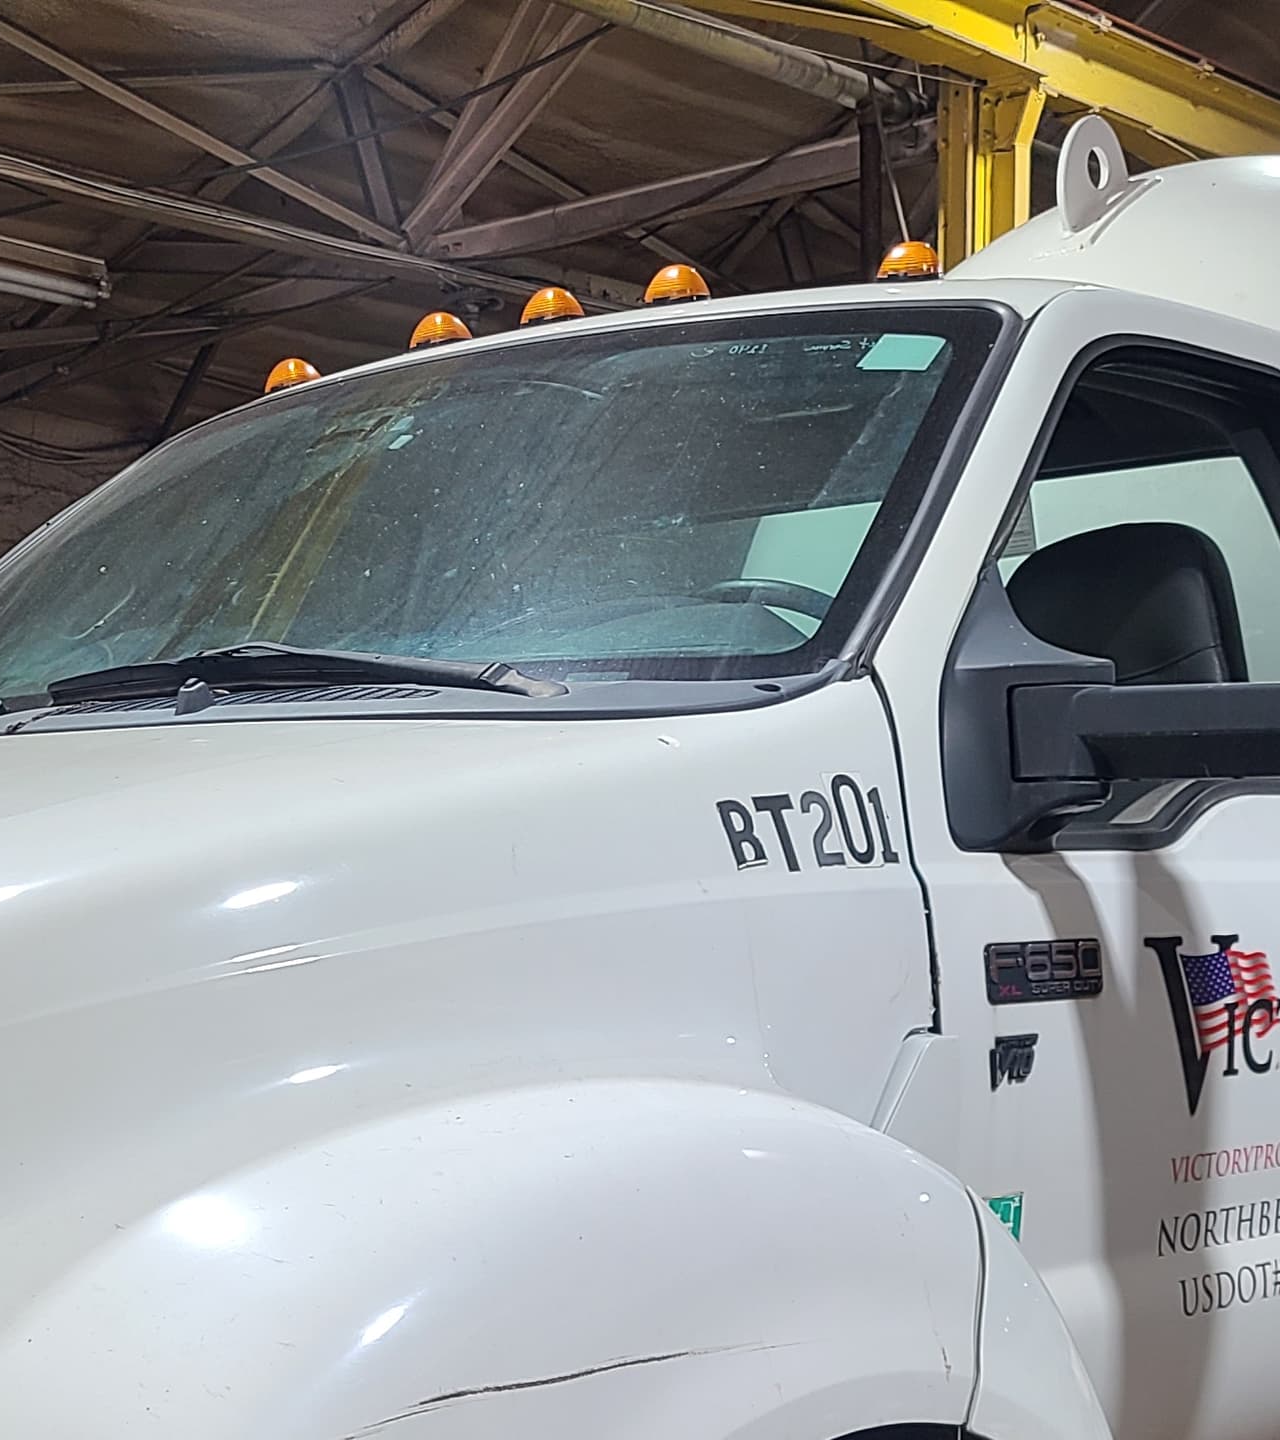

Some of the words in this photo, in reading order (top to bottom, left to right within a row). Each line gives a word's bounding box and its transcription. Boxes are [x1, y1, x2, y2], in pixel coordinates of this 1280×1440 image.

[716, 773, 900, 874] BT201
[999, 983, 1024, 996] XL
[1031, 981, 1070, 994] SUPER
